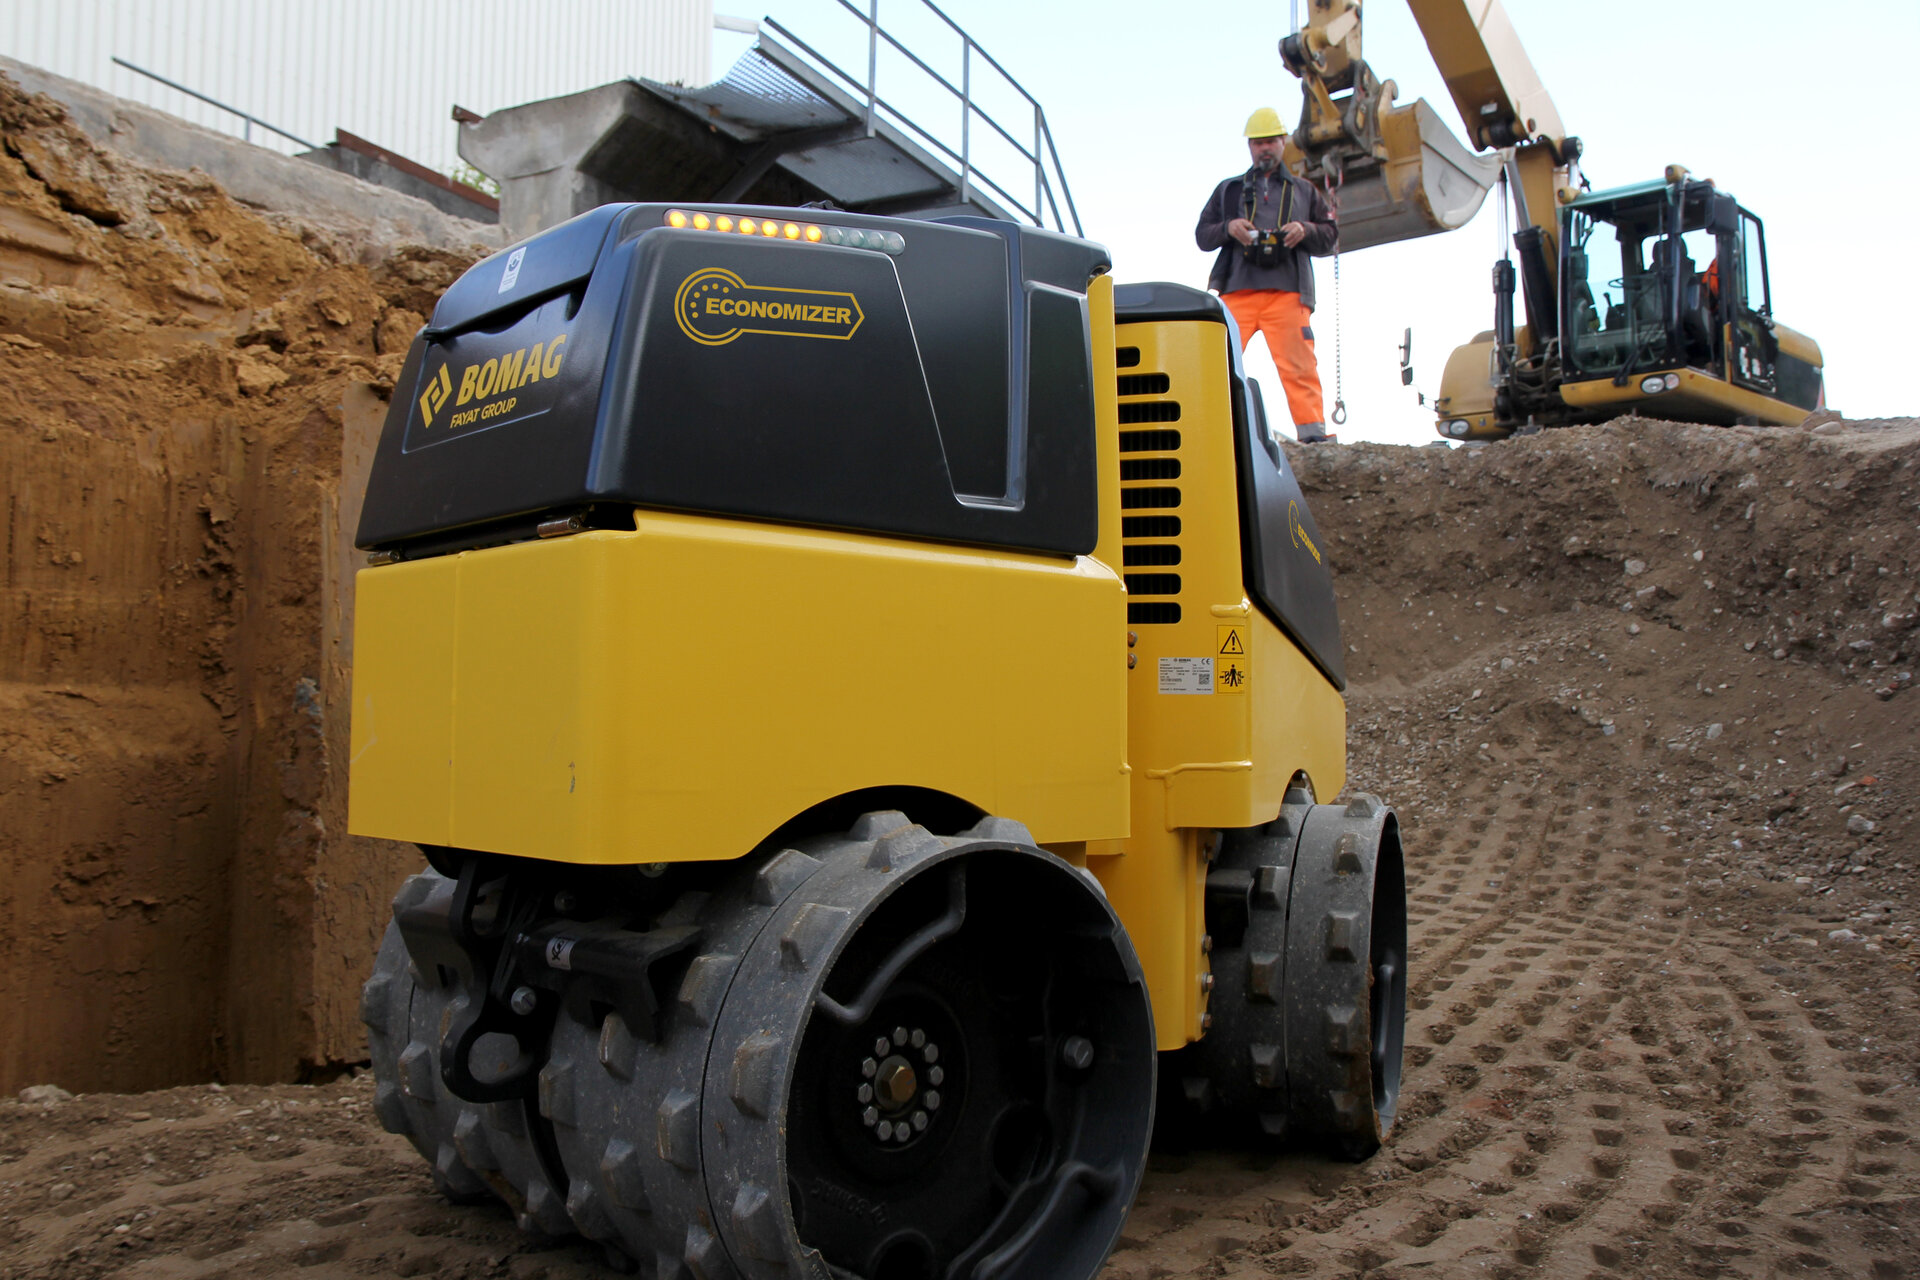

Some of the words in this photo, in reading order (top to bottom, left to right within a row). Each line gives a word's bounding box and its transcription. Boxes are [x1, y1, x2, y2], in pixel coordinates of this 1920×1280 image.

[705, 297, 851, 325] ECONOMIZER
[456, 334, 567, 406] BOMAG
[450, 408, 480, 429] FAYAT
[481, 397, 517, 420] GROUP
